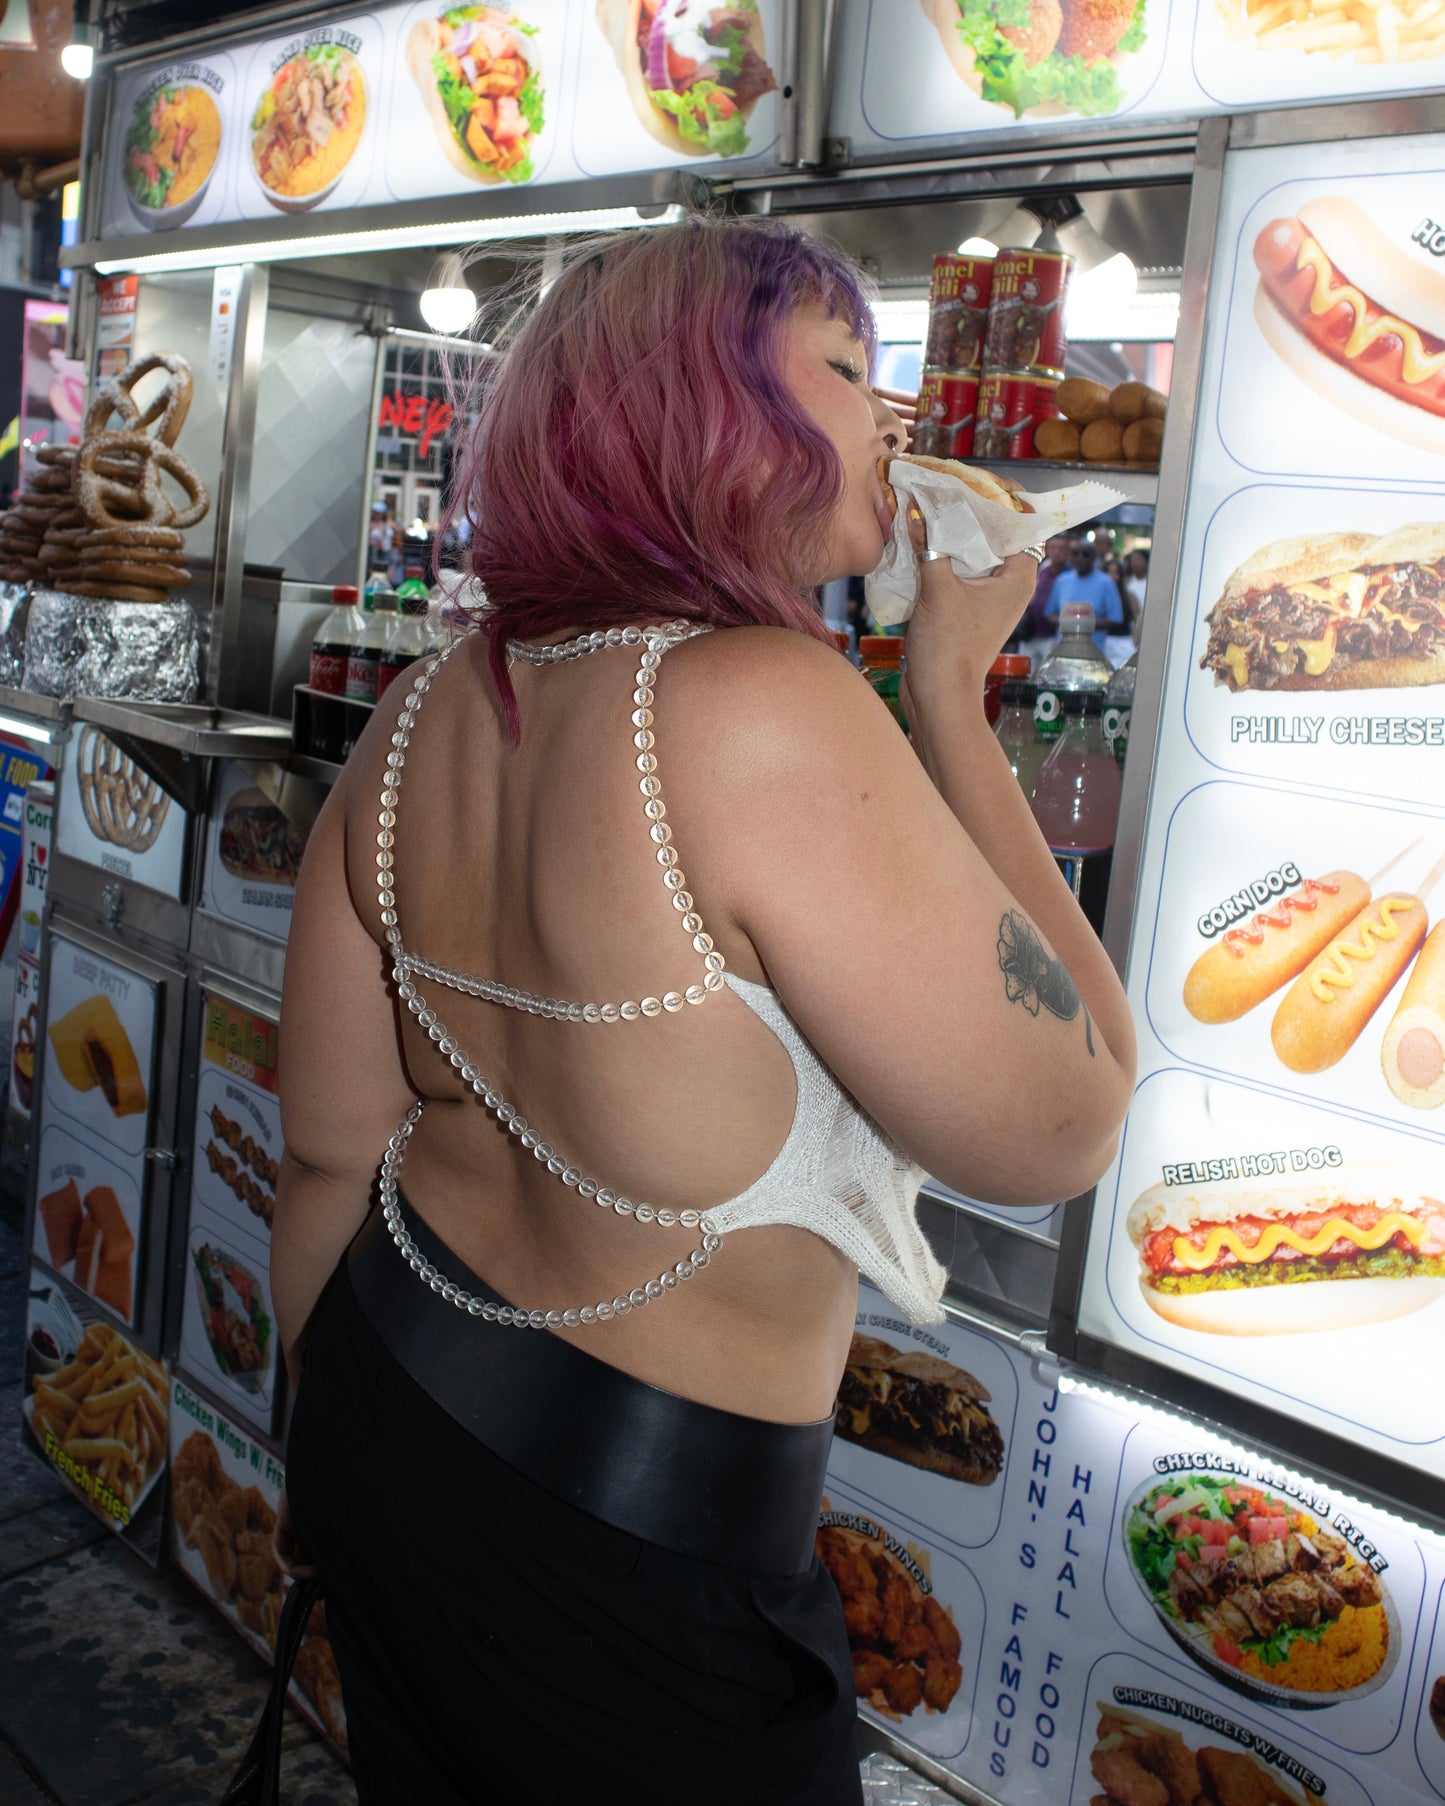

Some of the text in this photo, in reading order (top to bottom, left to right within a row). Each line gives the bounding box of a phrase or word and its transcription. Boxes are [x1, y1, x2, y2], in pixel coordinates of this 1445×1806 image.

[1231, 716, 1445, 745] PHILLY CHEESE
[1198, 861, 1303, 939] CORN DOG
[1162, 1145, 1343, 1187] RELISH HOT DOG
[868, 1313, 912, 1337] CHEESE
[911, 1327, 951, 1358] STEAK
[216, 1416, 247, 1460] Wings
[1153, 1452, 1250, 1477] CHICKEN
[44, 1430, 131, 1527] French Fries
[817, 1511, 932, 1596] CHICKEN WINGS
[1031, 1464, 1093, 1769] HALAL FOOD
[988, 1602, 1029, 1778] FAMOUS
[1113, 1685, 1181, 1718] CHICKEN
[1179, 1700, 1254, 1749] NUGGETS
